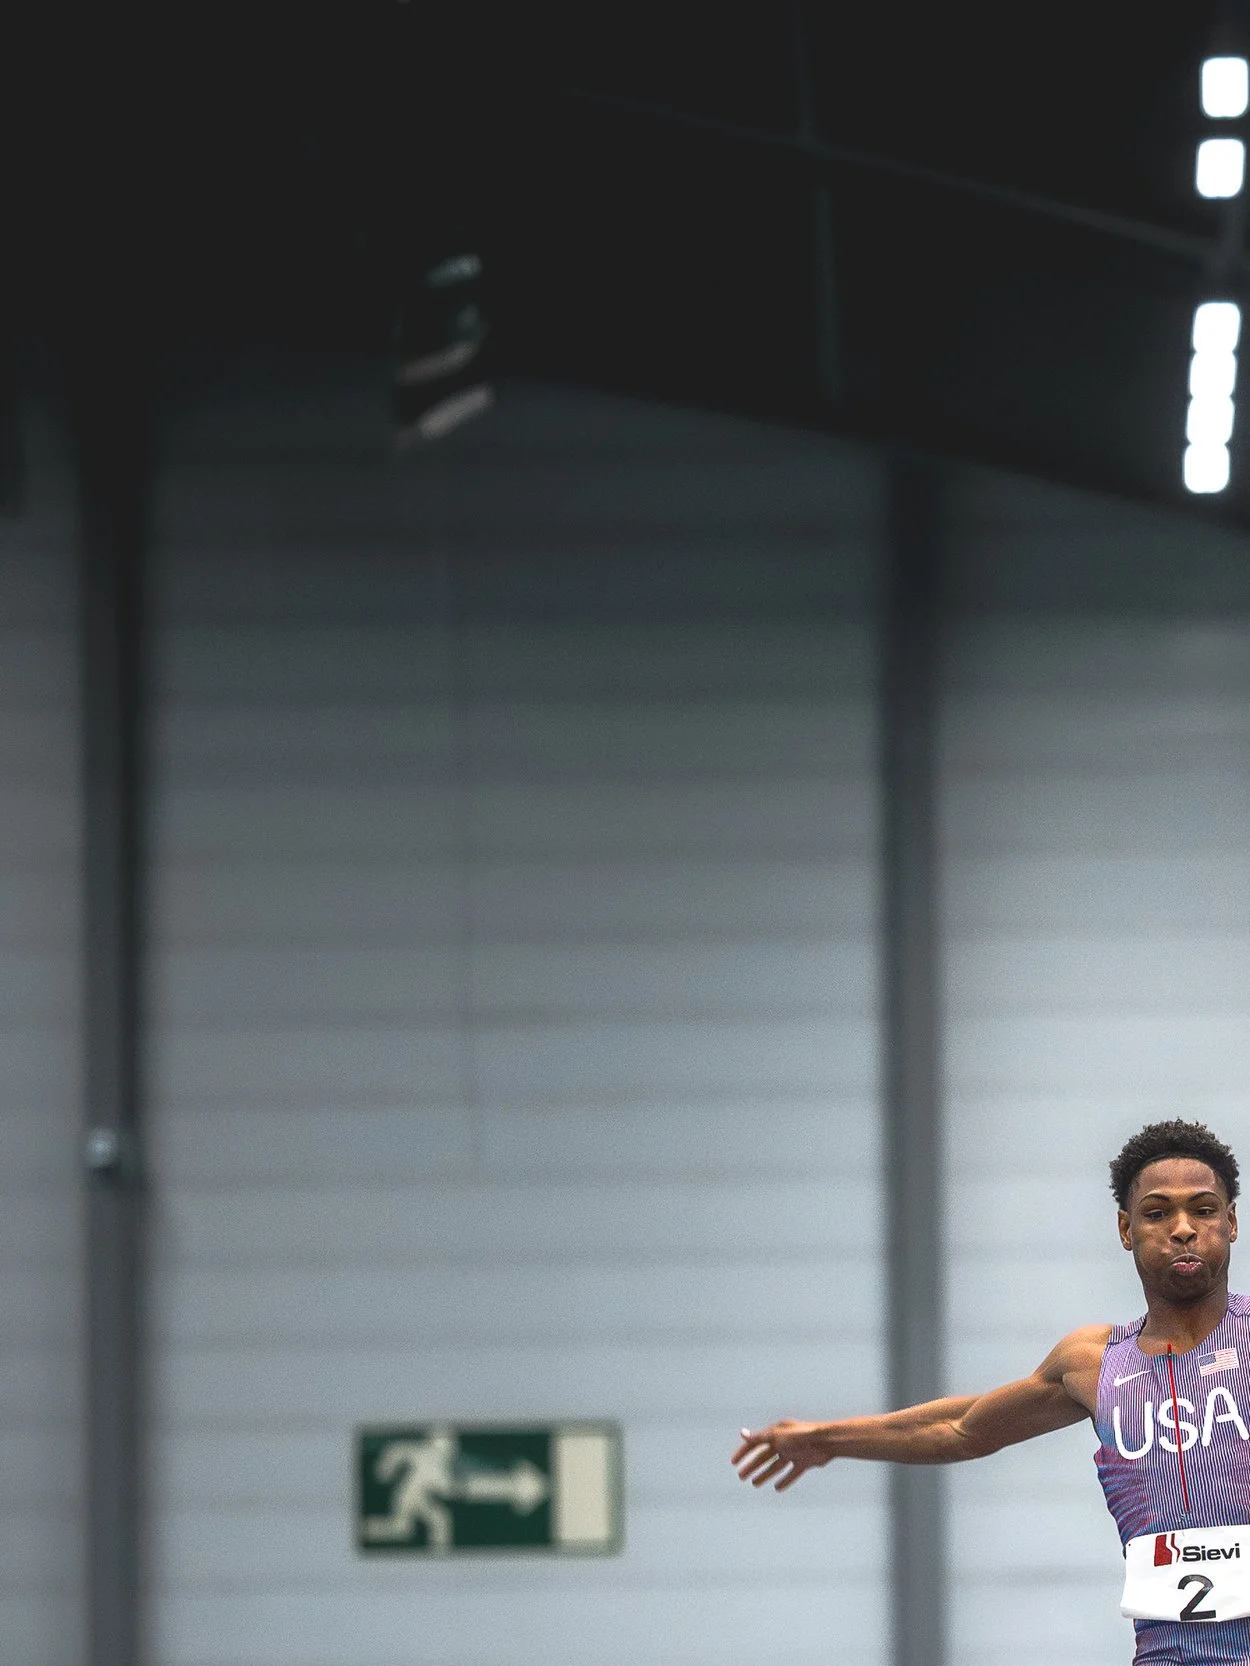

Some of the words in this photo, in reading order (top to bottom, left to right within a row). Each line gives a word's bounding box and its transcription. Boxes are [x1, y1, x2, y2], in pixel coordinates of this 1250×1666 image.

[1113, 1386, 1250, 1460] USA
[1182, 1543, 1241, 1562] Sievi
[1177, 1574, 1217, 1621] 2
